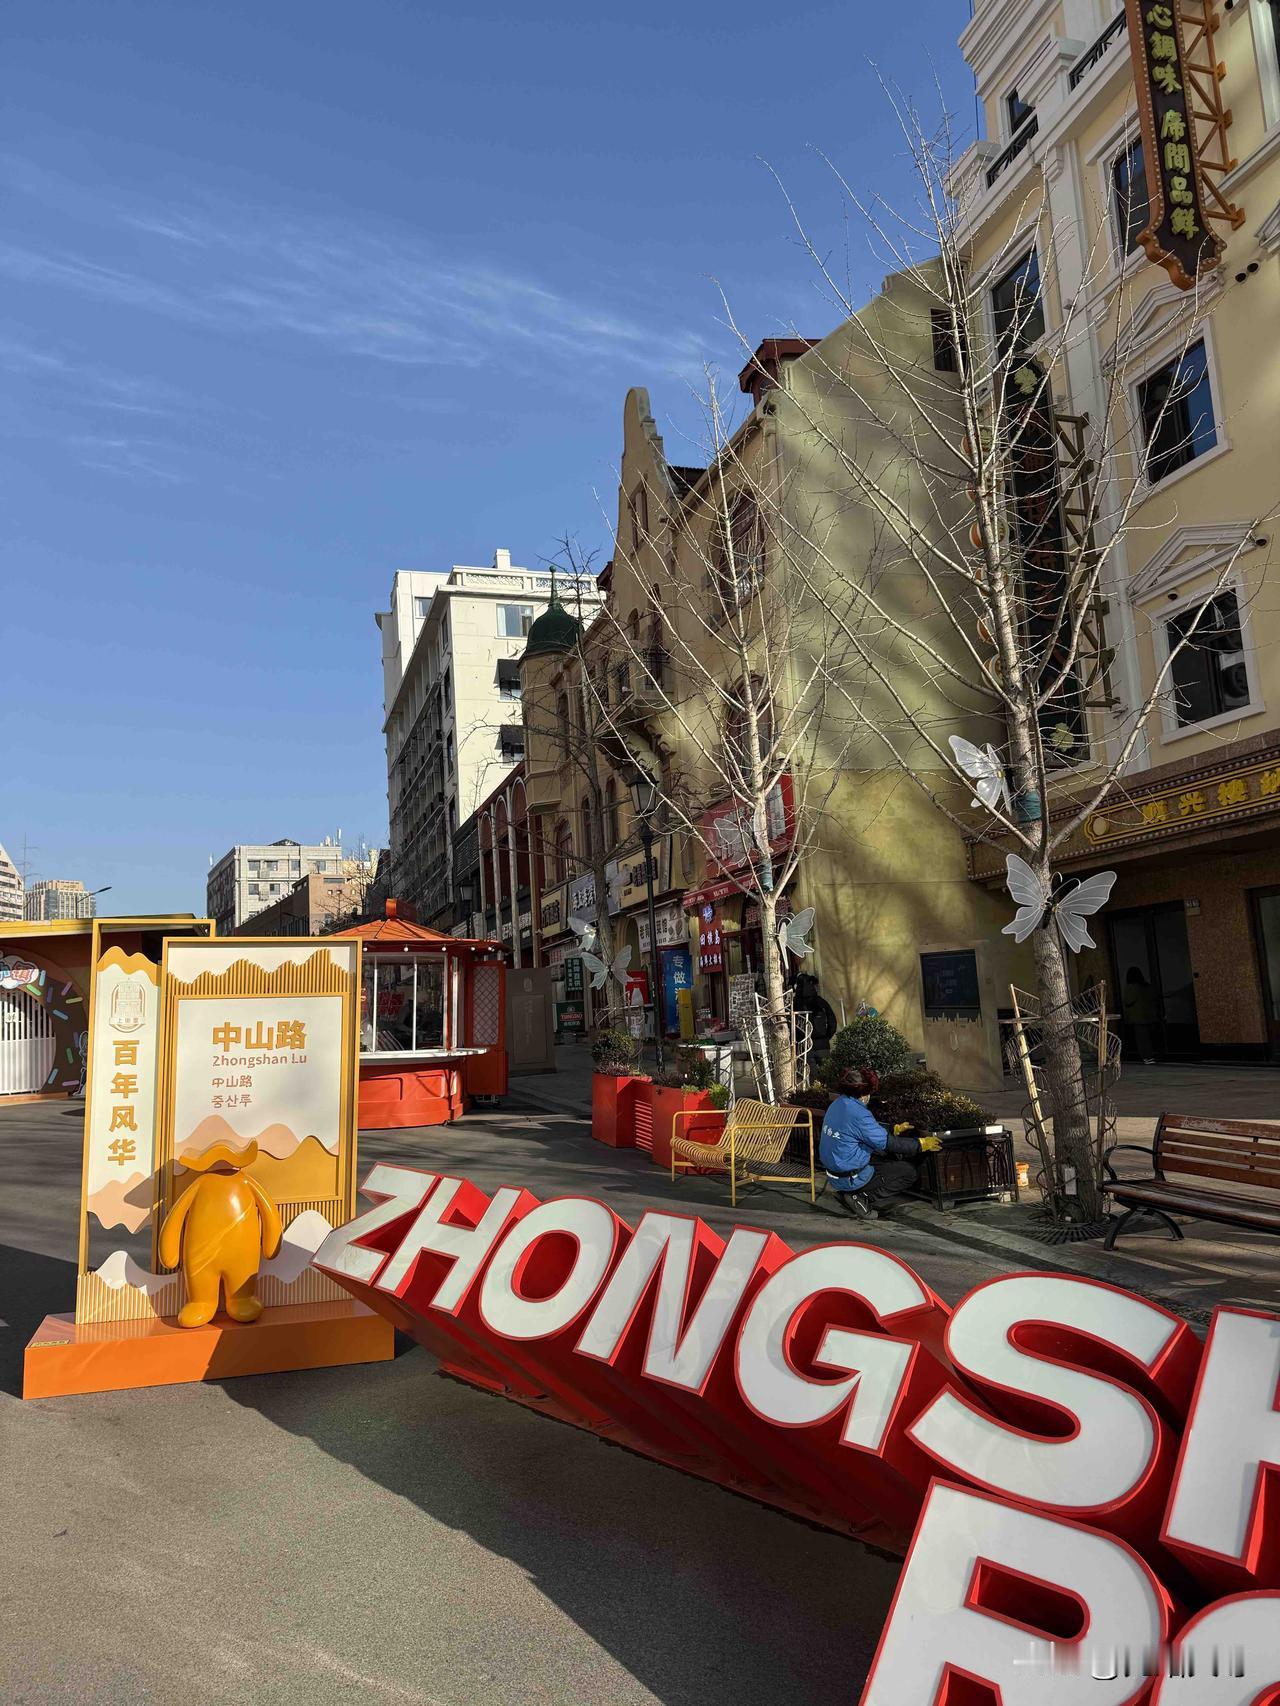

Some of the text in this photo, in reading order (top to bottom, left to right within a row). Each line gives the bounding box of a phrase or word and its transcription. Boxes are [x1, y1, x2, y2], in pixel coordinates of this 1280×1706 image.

[1146, 4, 1183, 96] 心調味
[672, 954, 687, 1001] 专做
[212, 1019, 307, 1053] 中山路
[212, 1053, 308, 1069] Zhongshan Lu
[211, 1074, 253, 1089] 中山路
[211, 1094, 253, 1109] 중산루
[107, 1038, 141, 1167] 百年风华
[858, 1475, 1280, 1706] R
